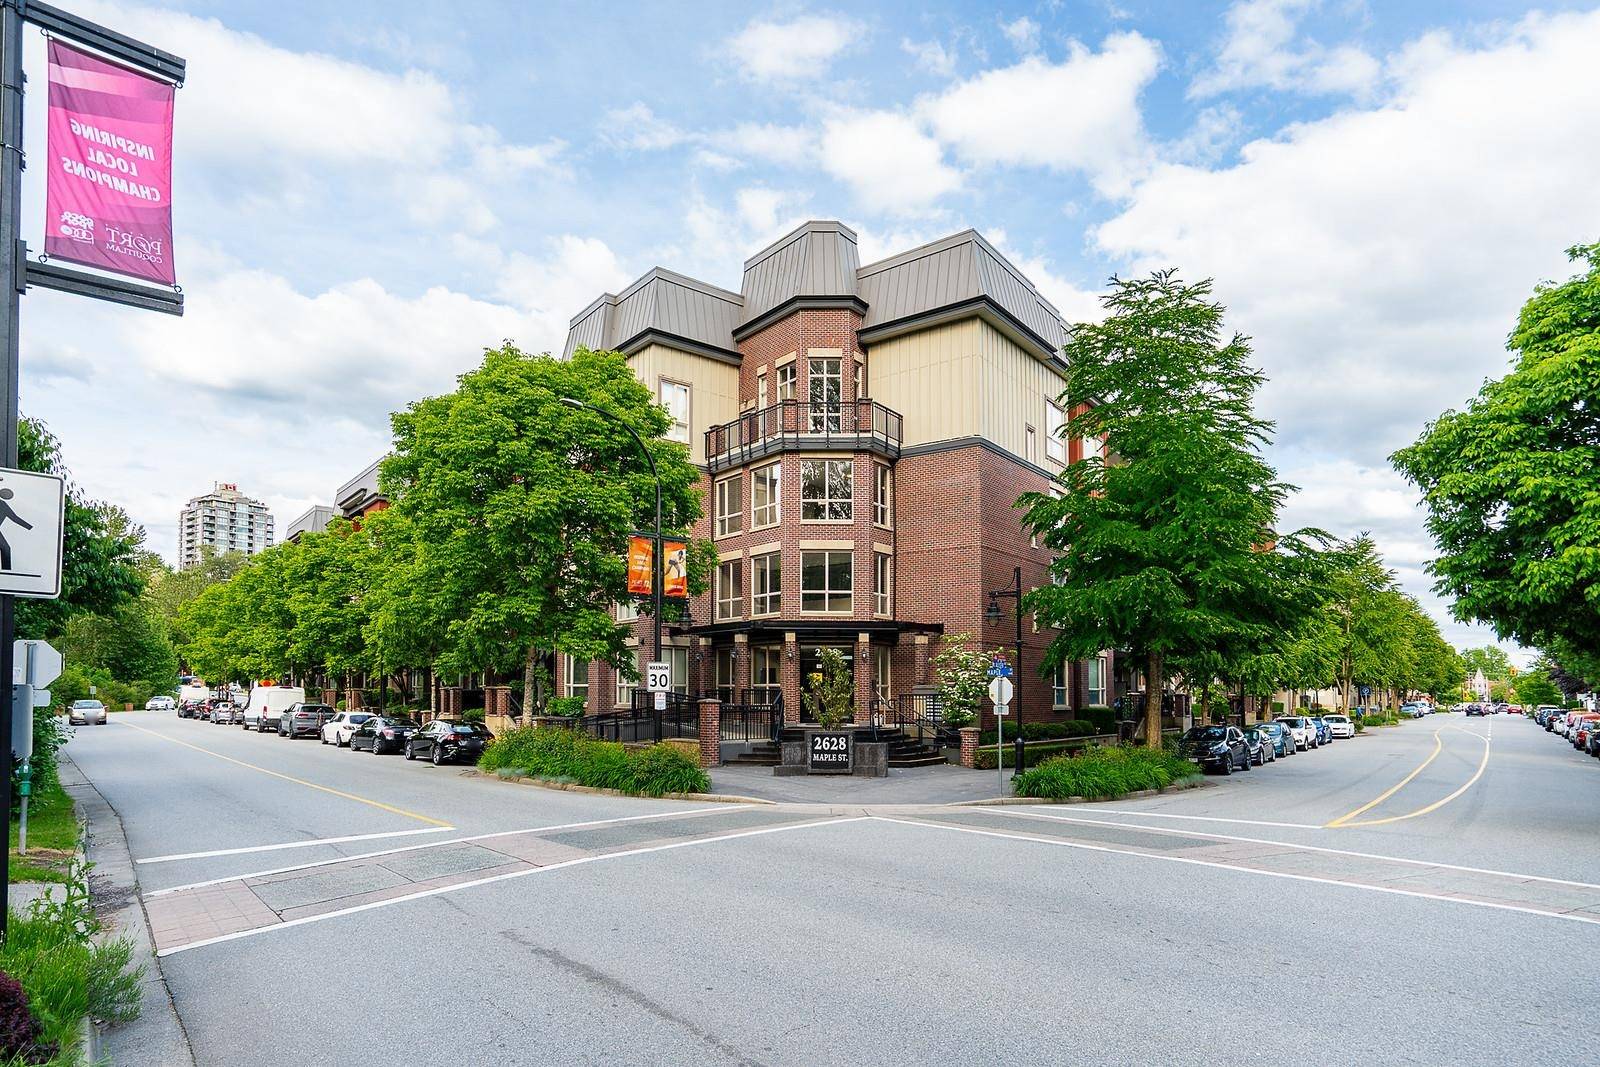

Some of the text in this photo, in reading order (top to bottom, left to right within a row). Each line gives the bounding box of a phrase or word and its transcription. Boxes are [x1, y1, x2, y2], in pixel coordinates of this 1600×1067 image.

[649, 673, 668, 688] 30
[814, 736, 847, 751] 2628
[812, 753, 849, 762] MAPLE ST.
